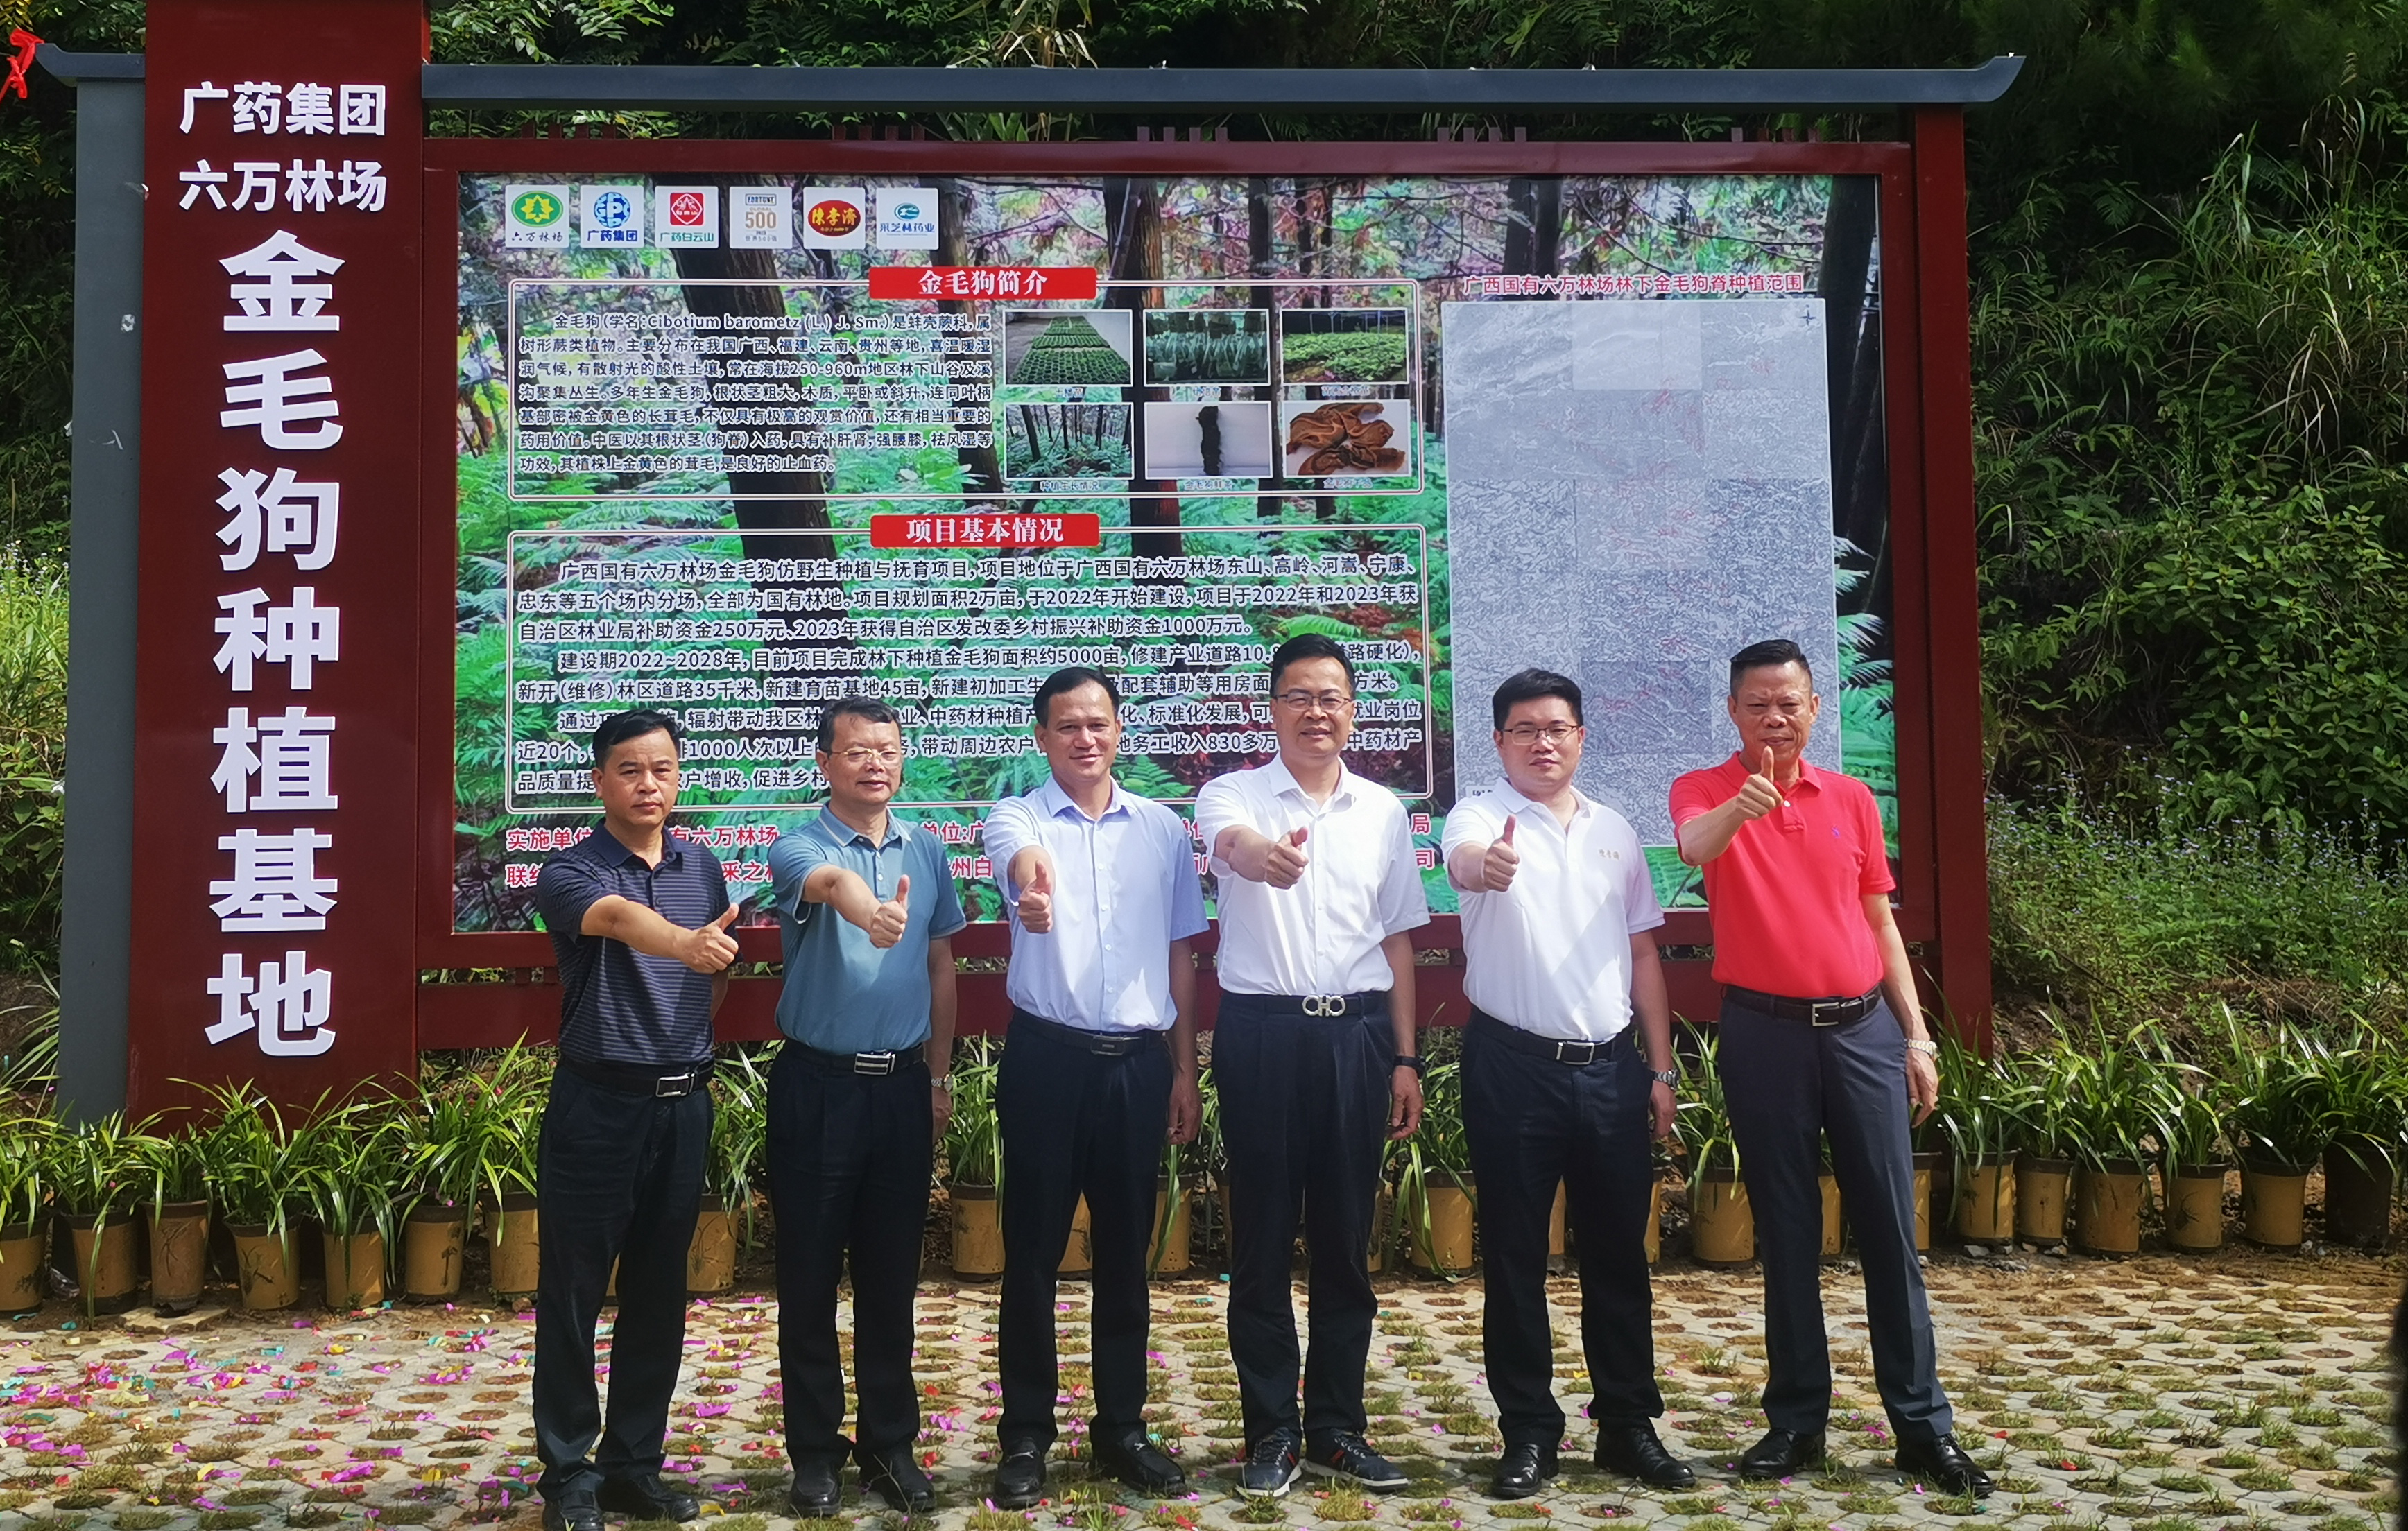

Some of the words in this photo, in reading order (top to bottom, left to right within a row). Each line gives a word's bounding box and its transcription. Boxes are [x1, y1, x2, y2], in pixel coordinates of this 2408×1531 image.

[180, 80, 386, 136] 广药集团
[179, 159, 386, 212] 六万林场
[745, 212, 777, 230] 500
[511, 231, 563, 242] 六万林场
[587, 230, 637, 241] 广药集团
[660, 232, 714, 242] 广药白云山
[918, 269, 1048, 296] 金毛狗简介
[1463, 273, 1803, 294] 广西国有六万林场林下金毛狗脊种植范围
[725, 313, 799, 328] barometz
[906, 517, 1065, 544] 项目基本情况
[205, 229, 346, 1057] 金毛狗种植基地
[1339, 640, 1420, 664] 路硬化），
[1411, 815, 1431, 835] 局
[1416, 849, 1435, 869] 司
